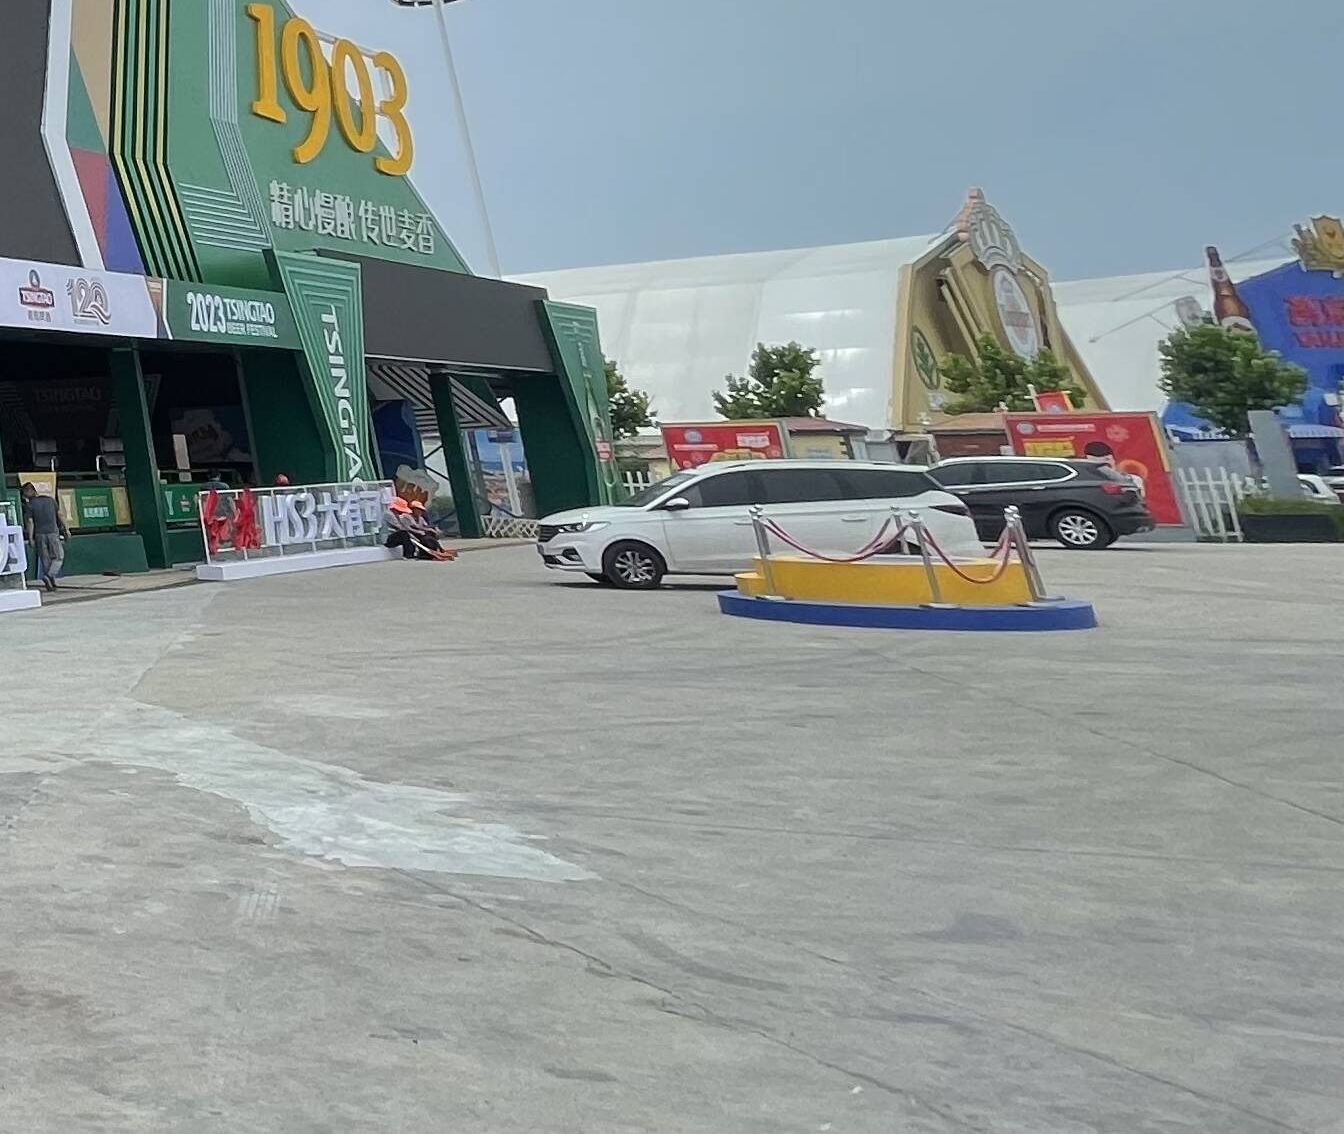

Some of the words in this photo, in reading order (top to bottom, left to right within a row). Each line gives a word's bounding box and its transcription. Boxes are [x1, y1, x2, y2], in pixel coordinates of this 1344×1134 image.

[245, 2, 414, 176] 1903
[358, 199, 436, 255] 传世麦香
[186, 291, 226, 334] 2023
[224, 298, 275, 324] TSINGTAO
[261, 493, 318, 546] HS3
